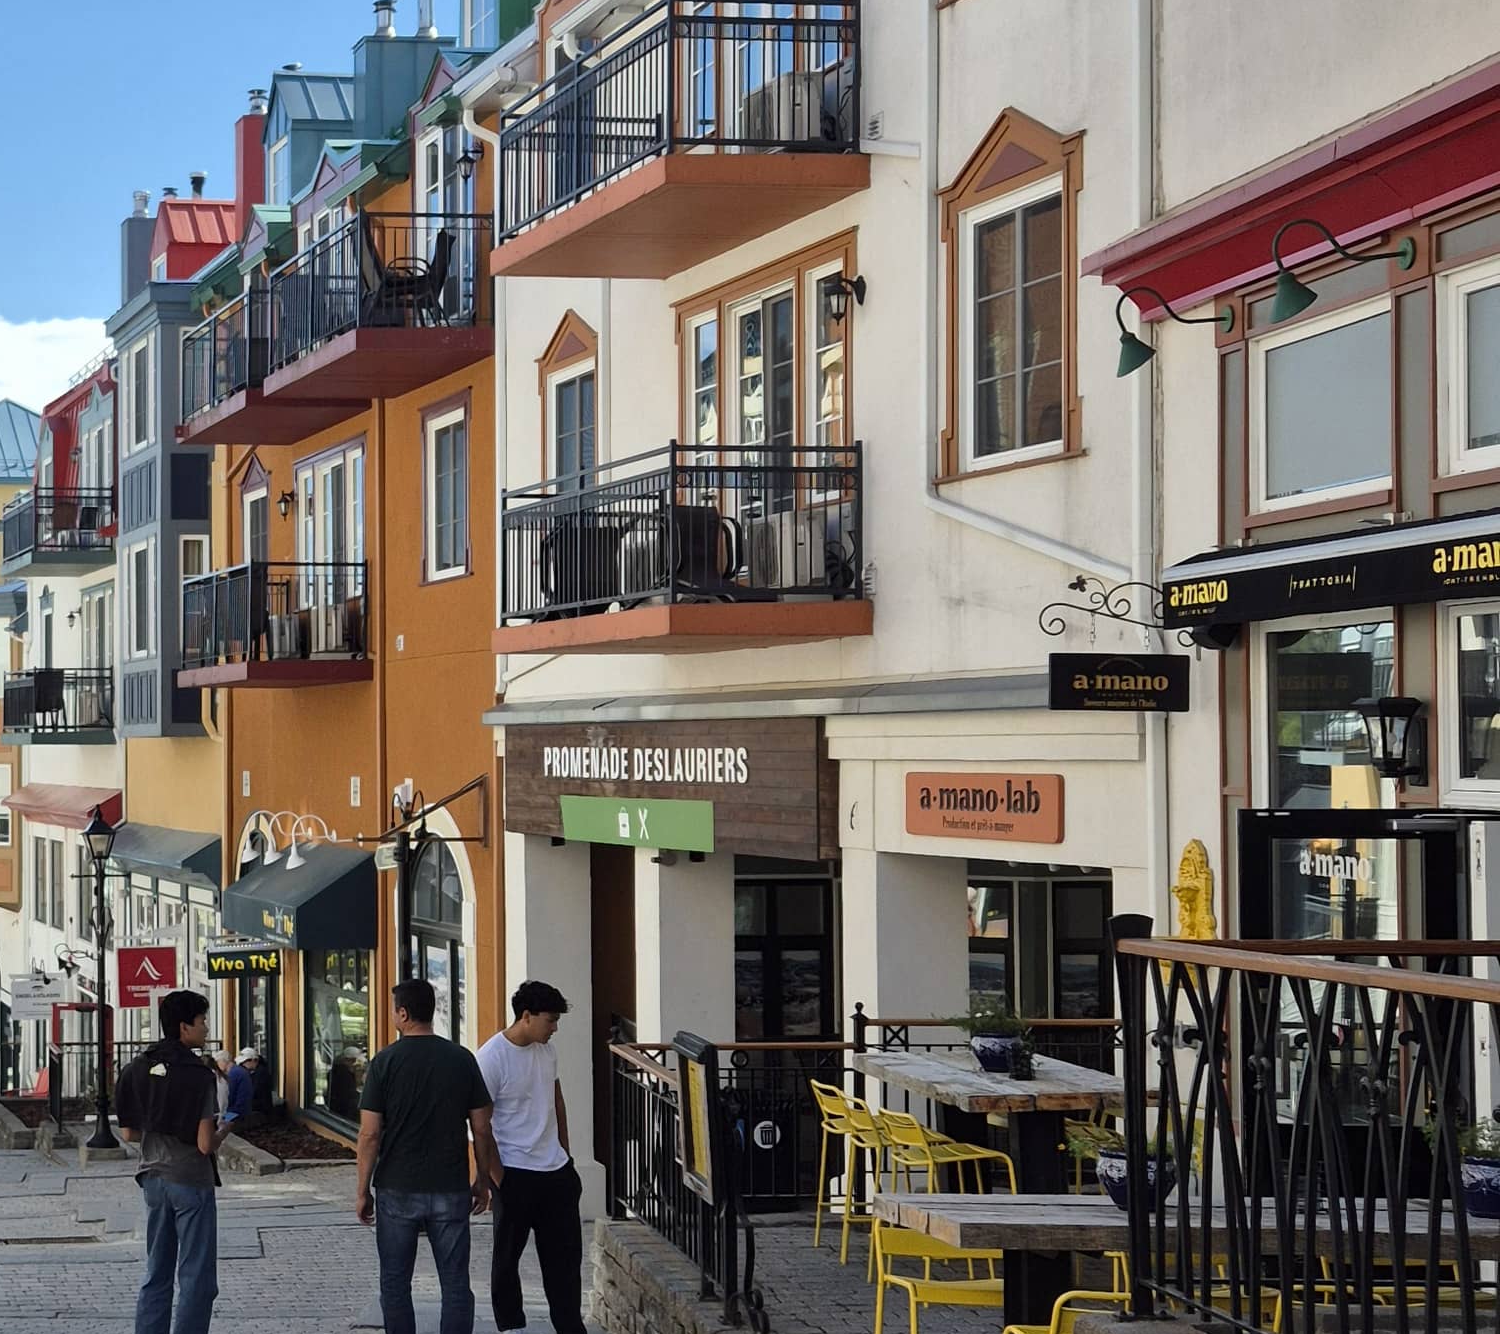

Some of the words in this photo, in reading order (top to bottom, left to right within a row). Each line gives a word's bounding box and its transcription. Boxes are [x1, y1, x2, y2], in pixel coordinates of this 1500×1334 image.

[543, 745, 629, 780] PROMENADE
[633, 746, 749, 784] DESLAURIERS
[210, 956, 245, 971] Viva
[249, 951, 278, 972] Thé
